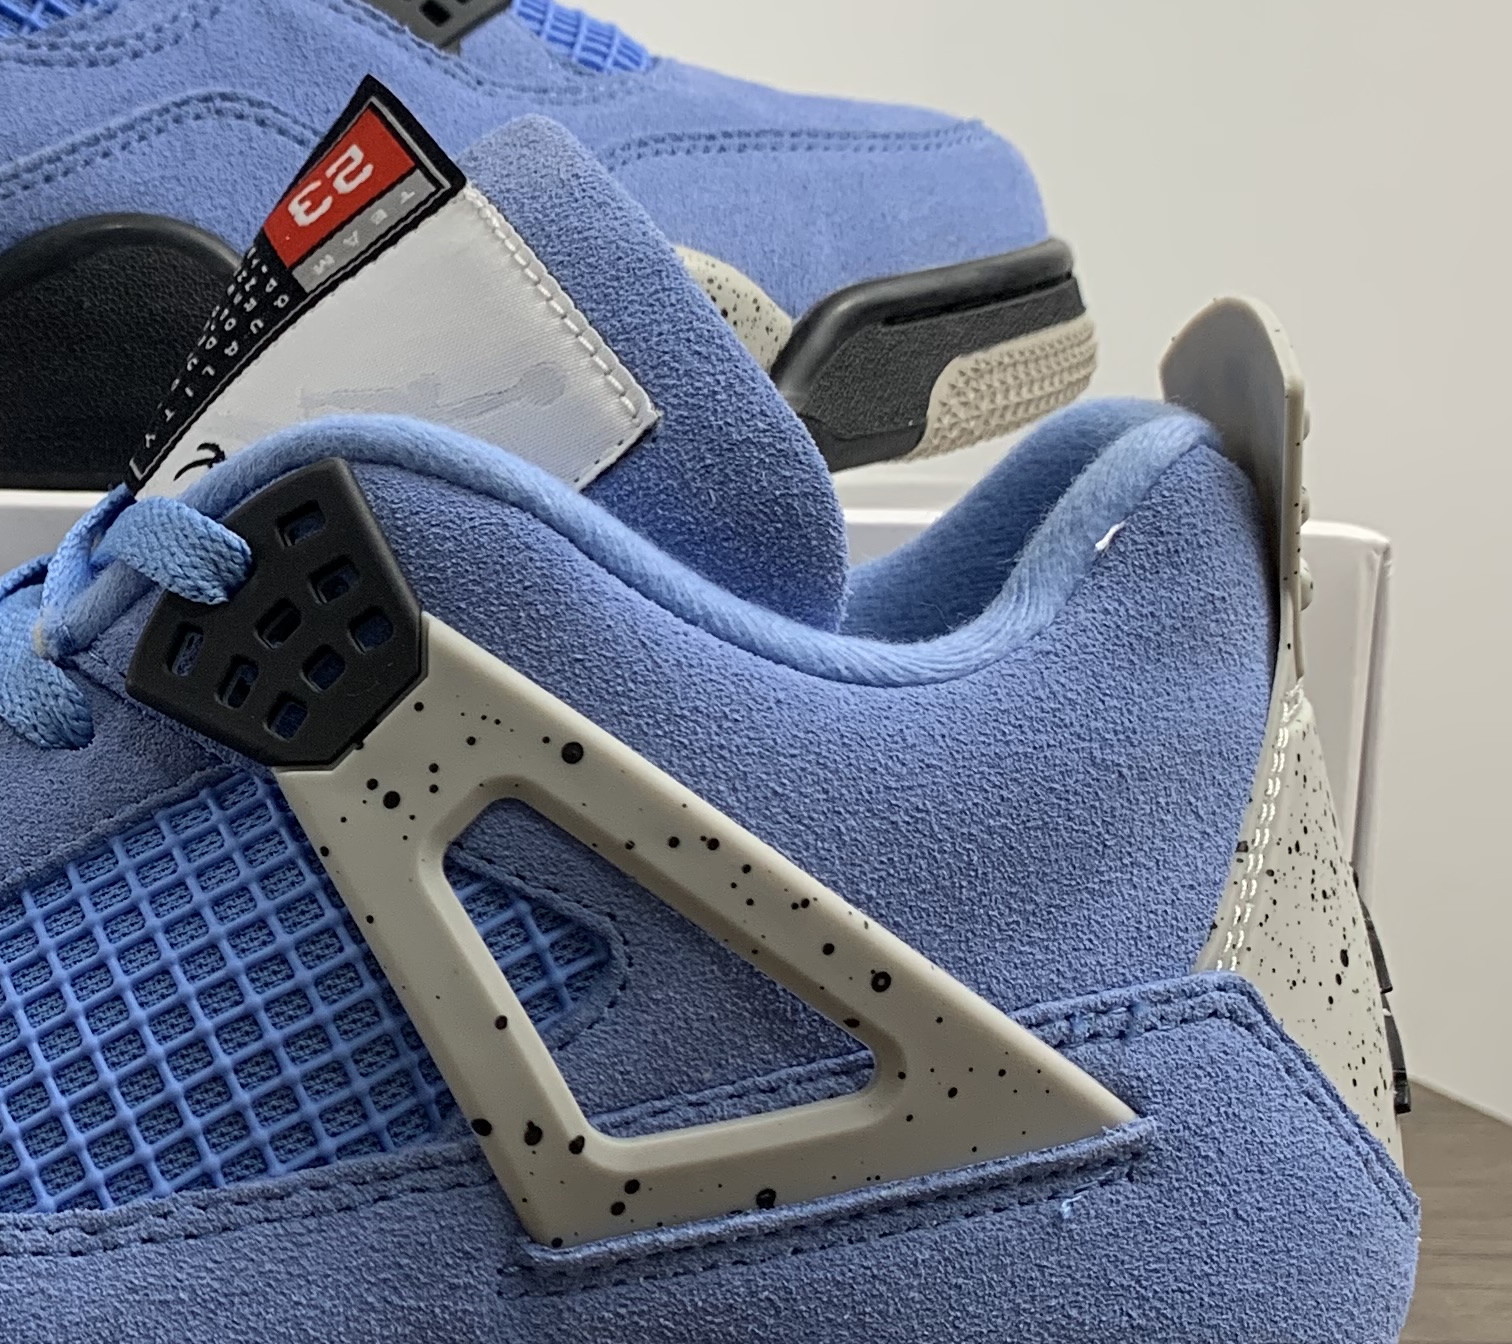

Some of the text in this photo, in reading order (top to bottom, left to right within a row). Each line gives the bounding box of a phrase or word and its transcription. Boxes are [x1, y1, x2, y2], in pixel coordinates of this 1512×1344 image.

[287, 143, 374, 227] 23
[312, 189, 416, 276] TEAM
[144, 293, 289, 449] QUALITY
[156, 276, 278, 410] PRODU
